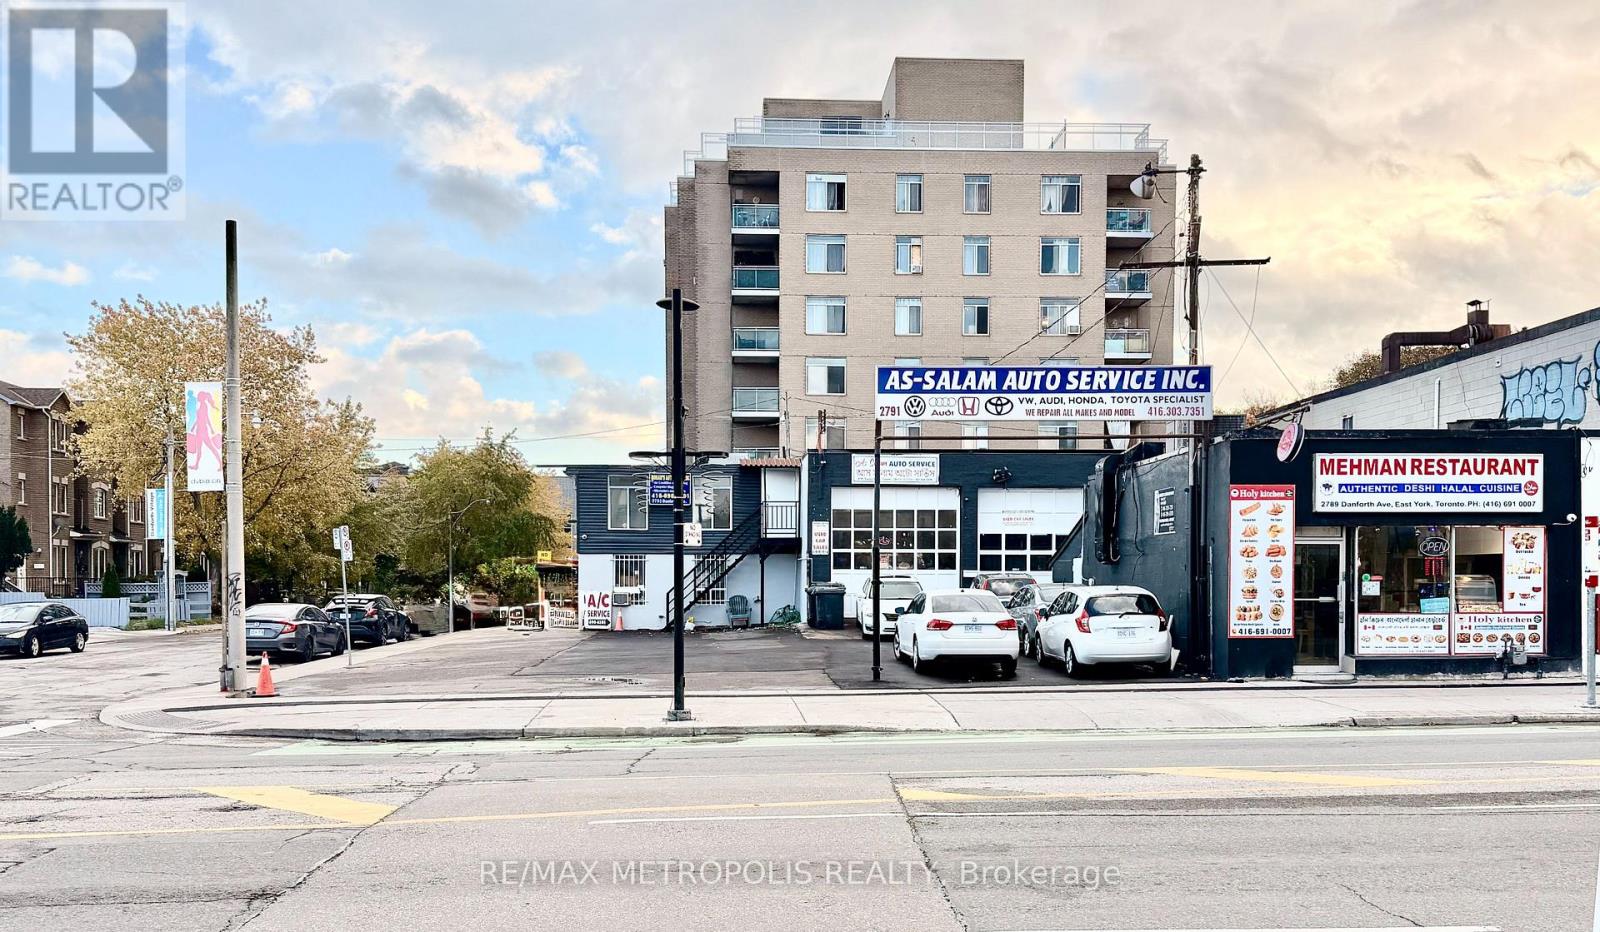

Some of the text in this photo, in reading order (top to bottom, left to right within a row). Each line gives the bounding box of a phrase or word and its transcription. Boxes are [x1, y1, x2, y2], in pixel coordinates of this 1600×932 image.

[885, 369, 1205, 391] AS-SALAM AUTO SERVICE INC.
[1018, 395, 1205, 406] VW, AUDI, HONDA, TOYOTA SPECIALIST
[879, 406, 900, 417] 2791
[1025, 408, 1135, 417] WE REPAIR ALL MAKES AND MODEL
[1147, 406, 1205, 417] 416.303.7351
[1320, 458, 1539, 476] MEHMAN RESTAURANT
[1239, 489, 1285, 499] Holy kitchen
[1340, 484, 1520, 493] AUTHENTIC DESHI HALAL CUISINE
[1482, 501, 1501, 509] (416)
[1421, 541, 1447, 552] OPEN
[587, 592, 610, 609] A/C
[587, 610, 610, 618] SERVICE
[1469, 615, 1494, 624] Holy
